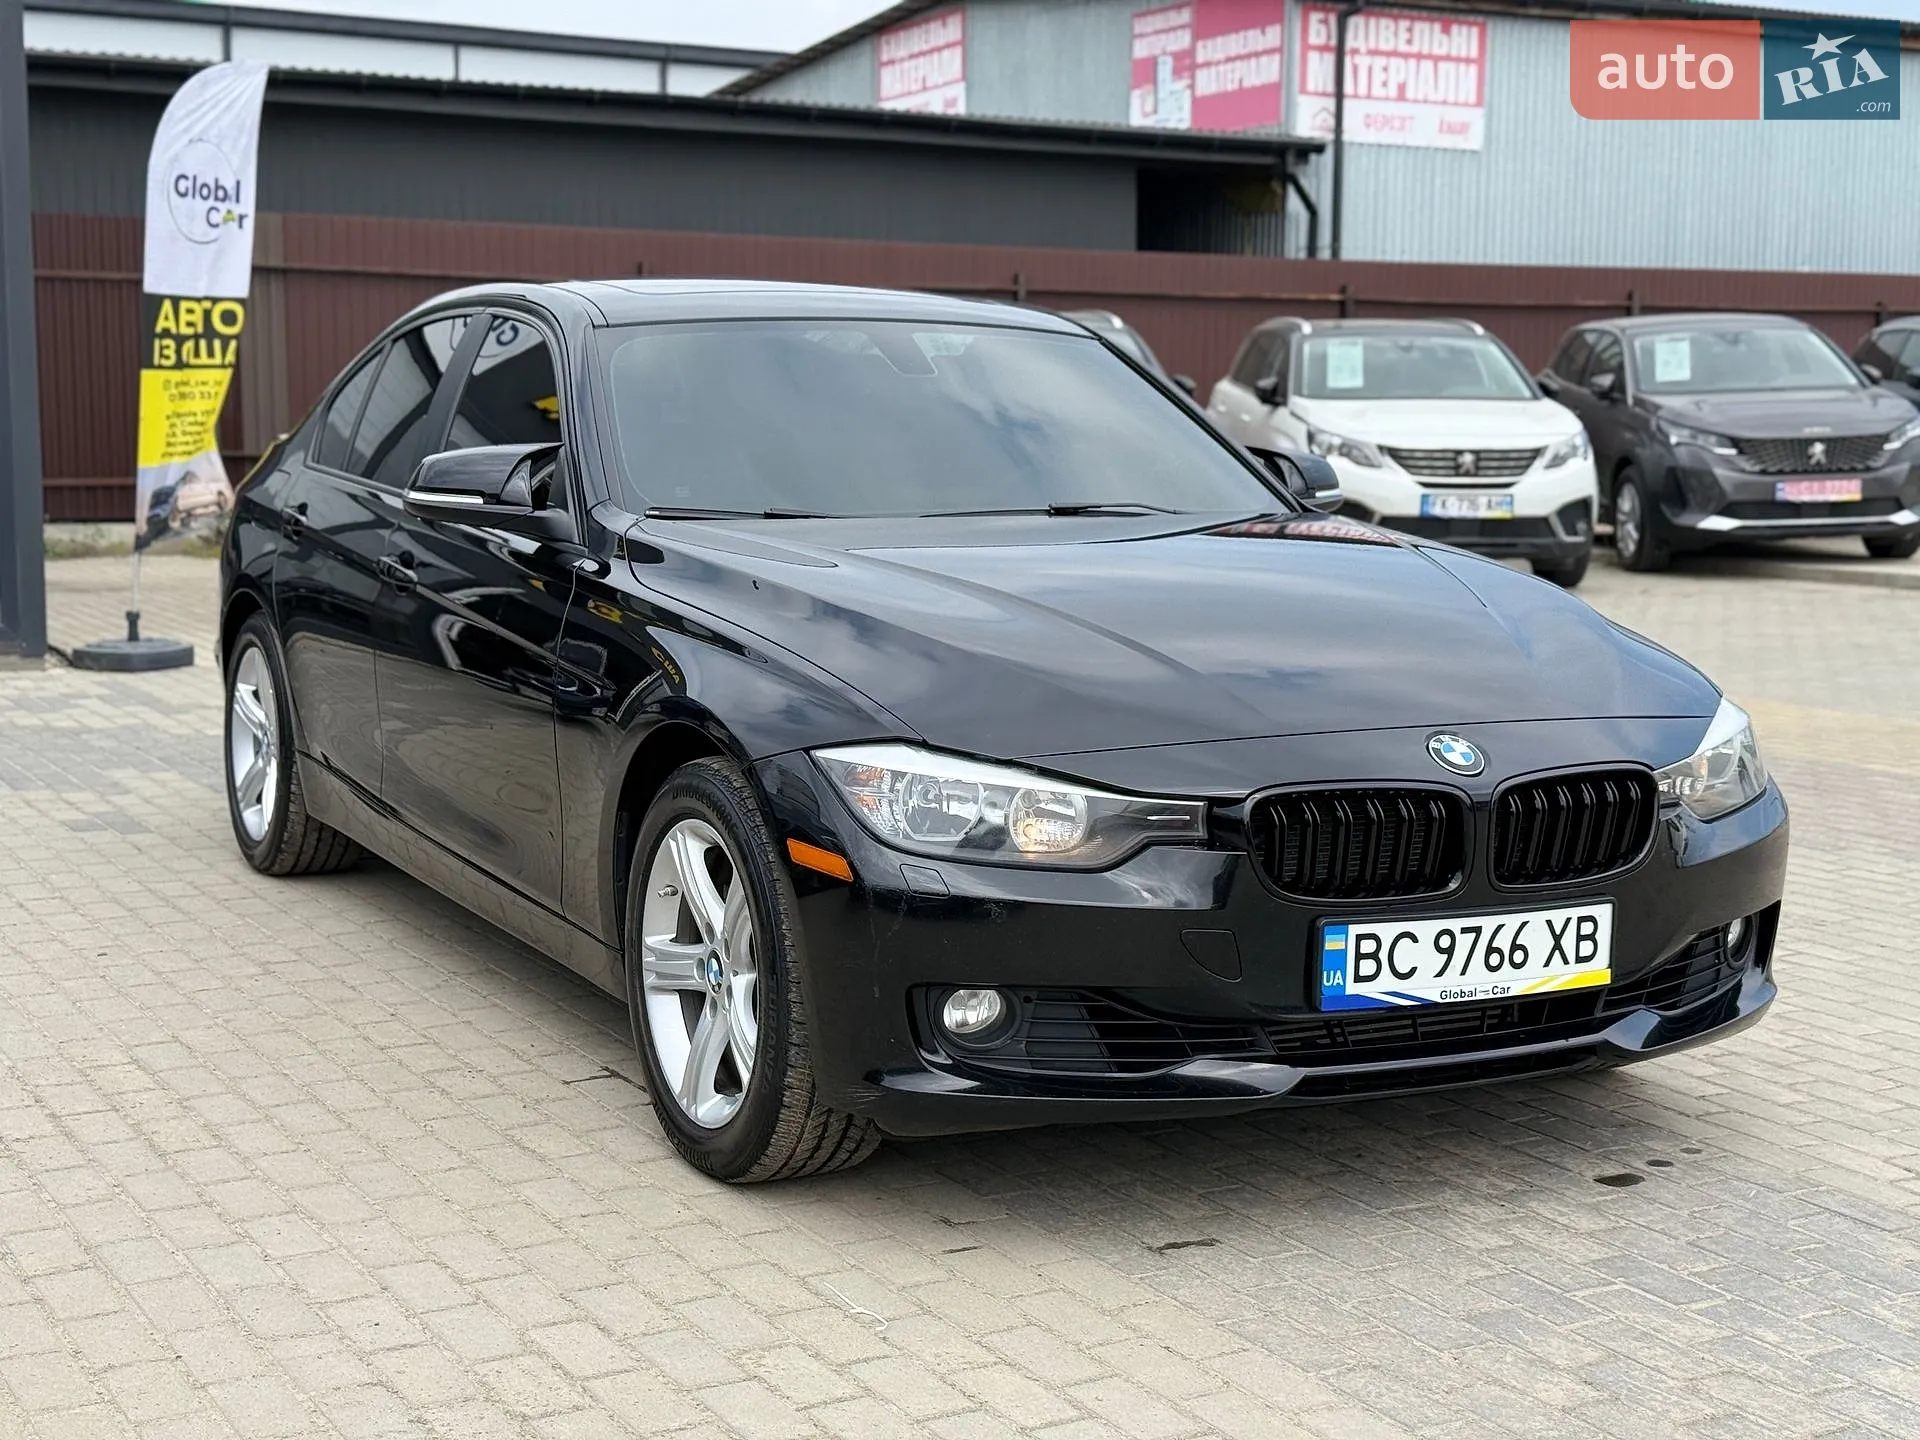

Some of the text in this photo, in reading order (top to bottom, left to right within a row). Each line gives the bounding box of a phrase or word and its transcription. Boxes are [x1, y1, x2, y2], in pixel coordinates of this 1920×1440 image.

[1306, 50, 1478, 105] МАТЕРІАЛИ
[1353, 915, 1599, 984] BC 9766 XB
[1323, 970, 1344, 987] UA
[1439, 985, 1512, 1001] Global Car
